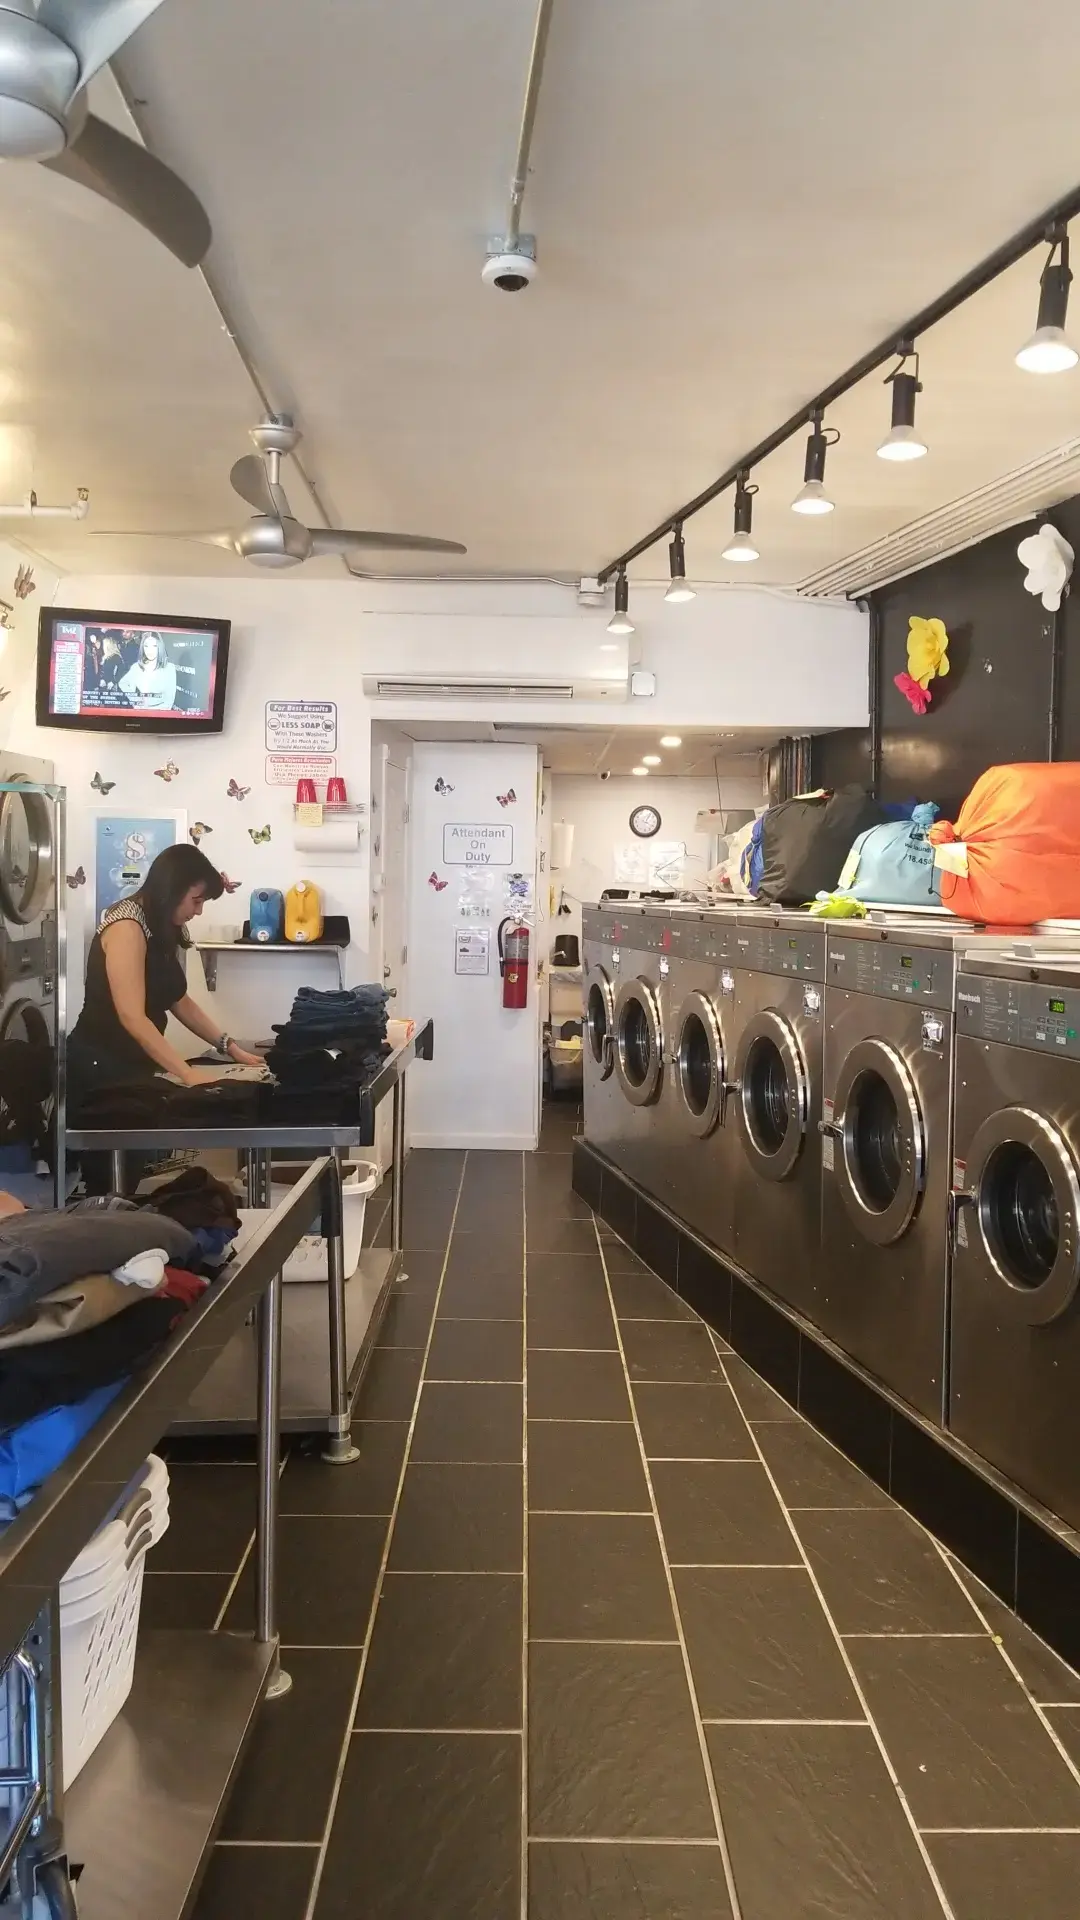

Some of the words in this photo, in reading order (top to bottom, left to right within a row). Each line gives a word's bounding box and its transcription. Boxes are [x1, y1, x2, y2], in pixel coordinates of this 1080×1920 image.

[451, 828, 506, 838] Attendant
[470, 840, 486, 849] On
[465, 851, 491, 864] Duty
